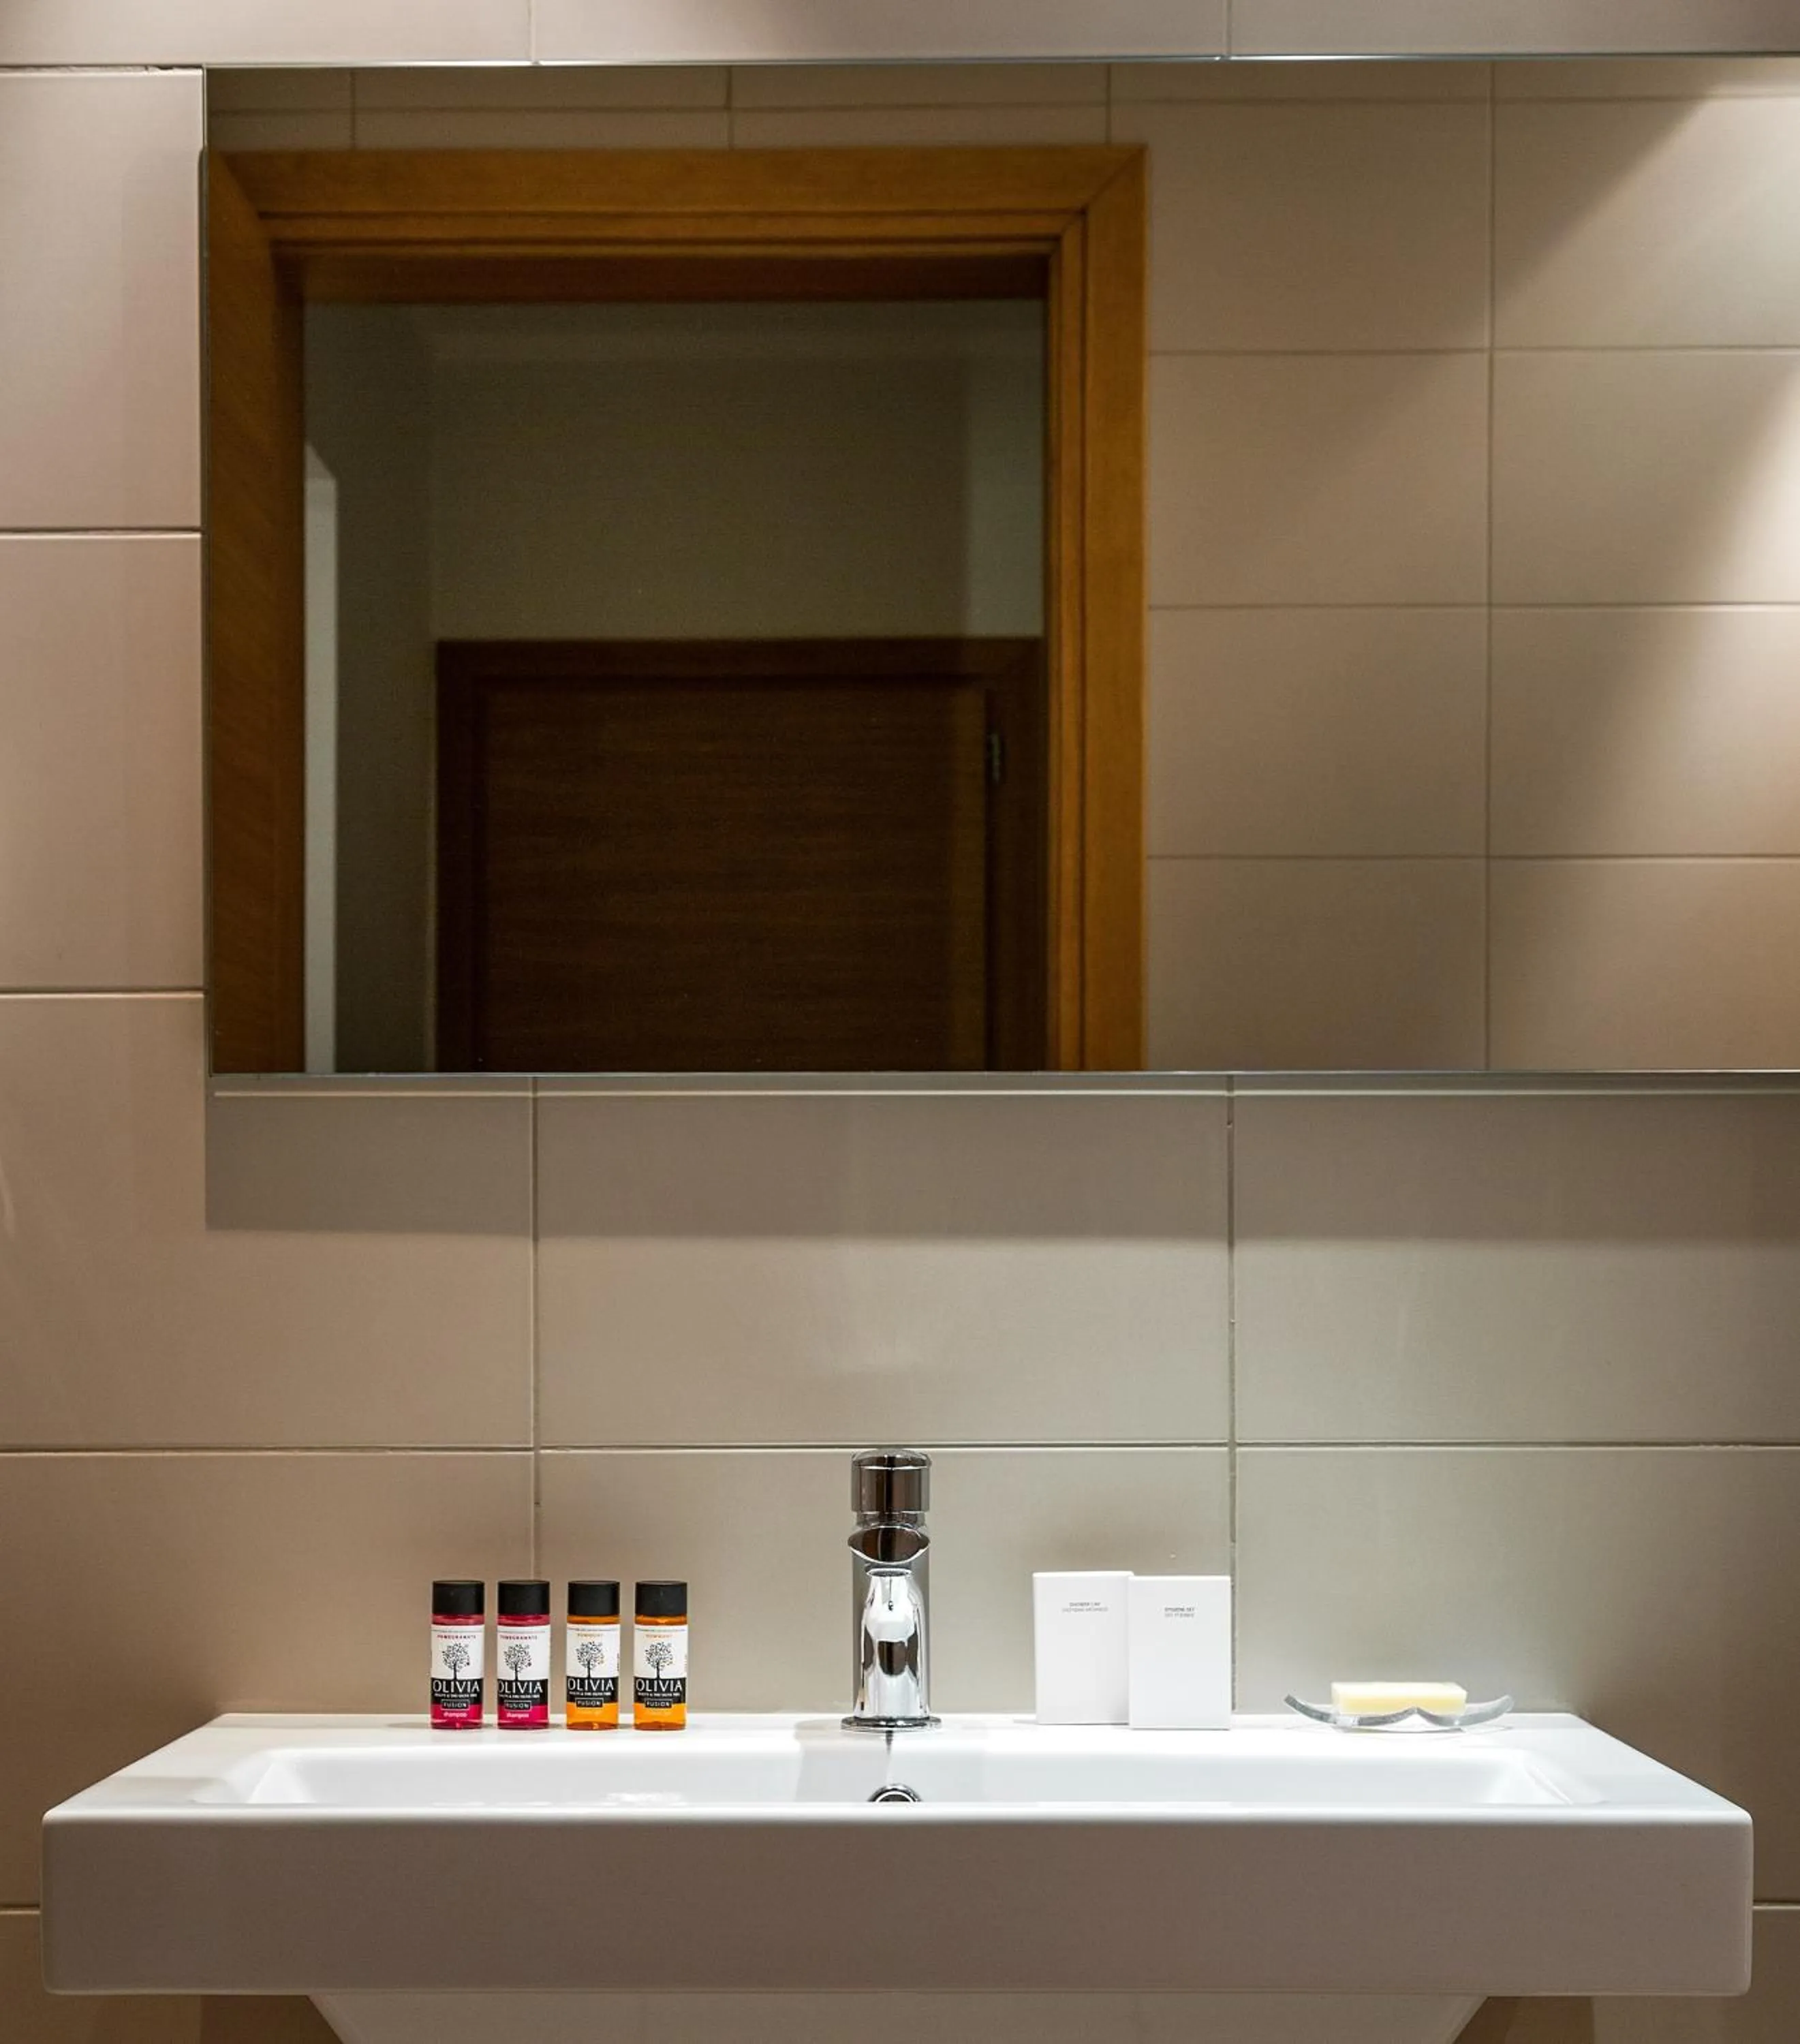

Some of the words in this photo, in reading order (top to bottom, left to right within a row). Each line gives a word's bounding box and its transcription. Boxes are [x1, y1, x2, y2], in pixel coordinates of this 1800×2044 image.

[433, 1679, 480, 1693] OLIVIA
[498, 1680, 543, 1694] OLIVIA
[568, 1678, 614, 1691] OLIVIA
[636, 1678, 682, 1692] OLIVIA
